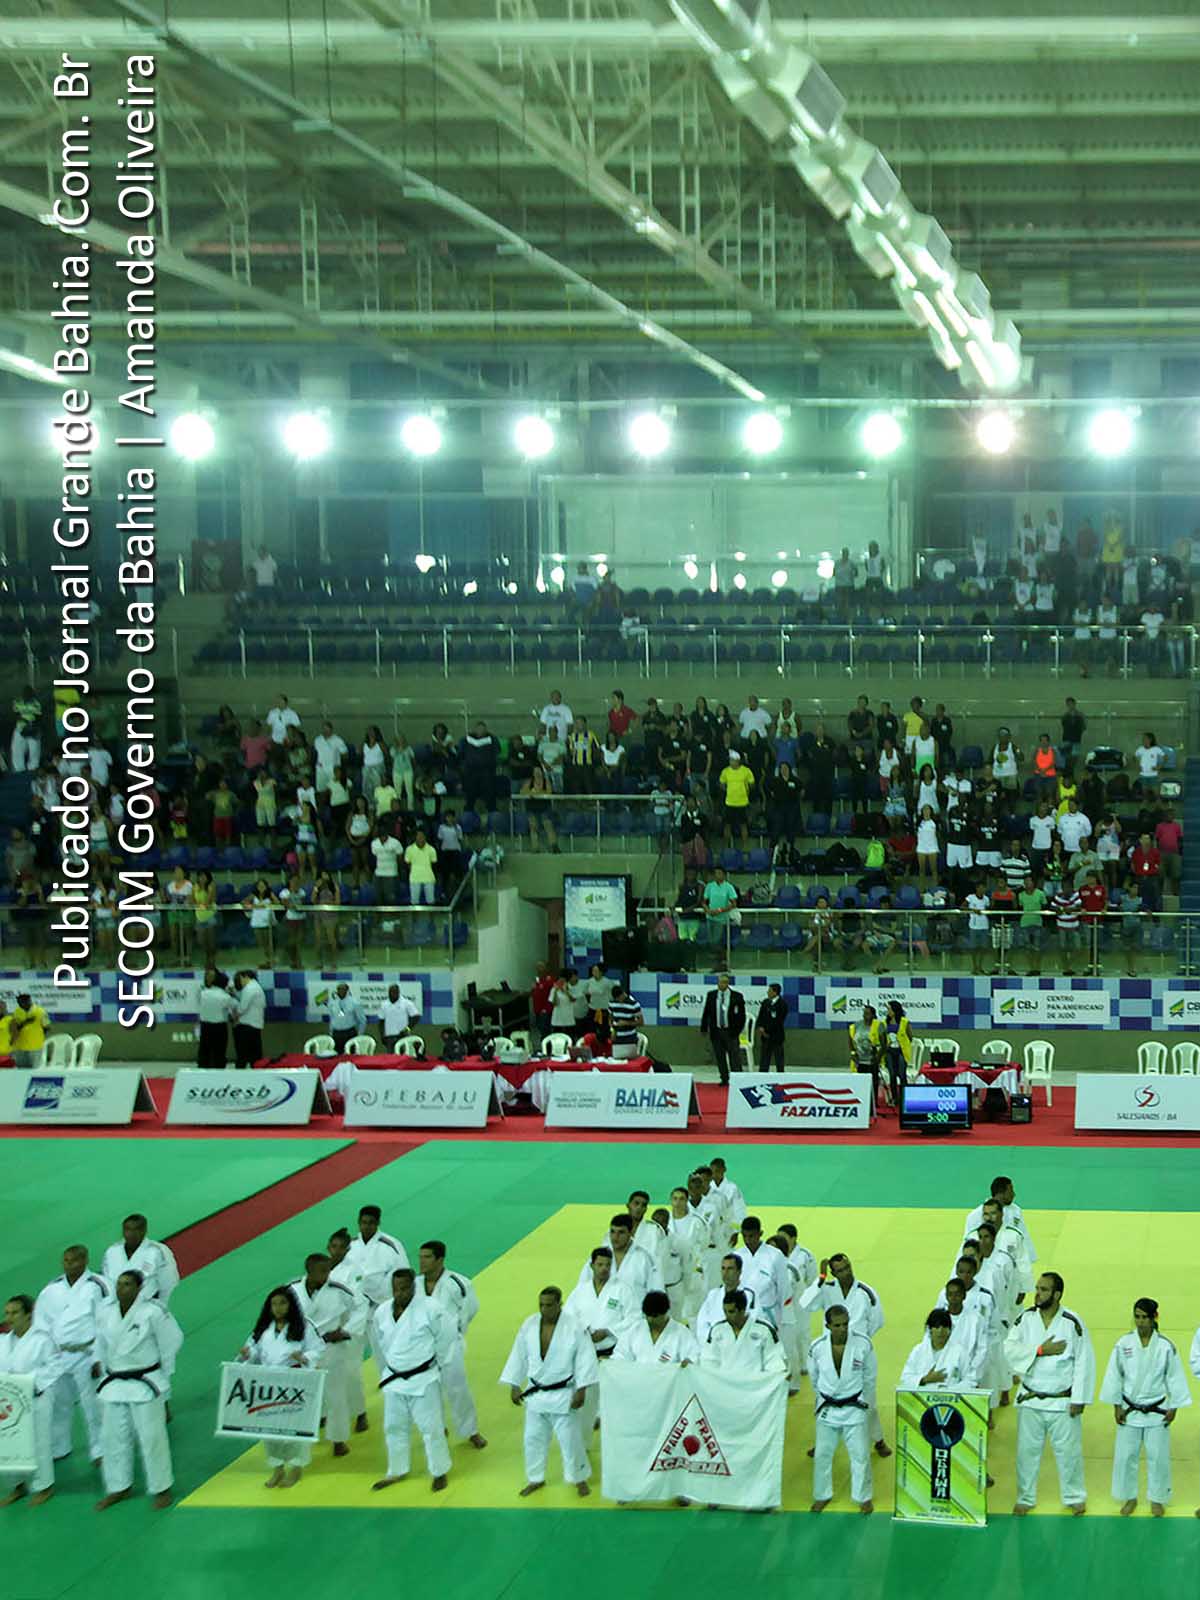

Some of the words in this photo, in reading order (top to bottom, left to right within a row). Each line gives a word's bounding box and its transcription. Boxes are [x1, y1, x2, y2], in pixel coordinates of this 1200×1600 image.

[1017, 1000, 1039, 1010] CBJ
[187, 1084, 271, 1099] sudesb
[383, 1089, 477, 1104] FEBAJU
[615, 1088, 679, 1107] BAHIA
[938, 1089, 956, 1099] 000
[780, 1105, 859, 1118] FAZATLETA
[938, 1101, 956, 1111] 000
[927, 1112, 949, 1123] 5:00
[227, 1378, 305, 1407] Ajuxx
[662, 1416, 690, 1456] PAULO
[694, 1417, 721, 1459] FRAGA
